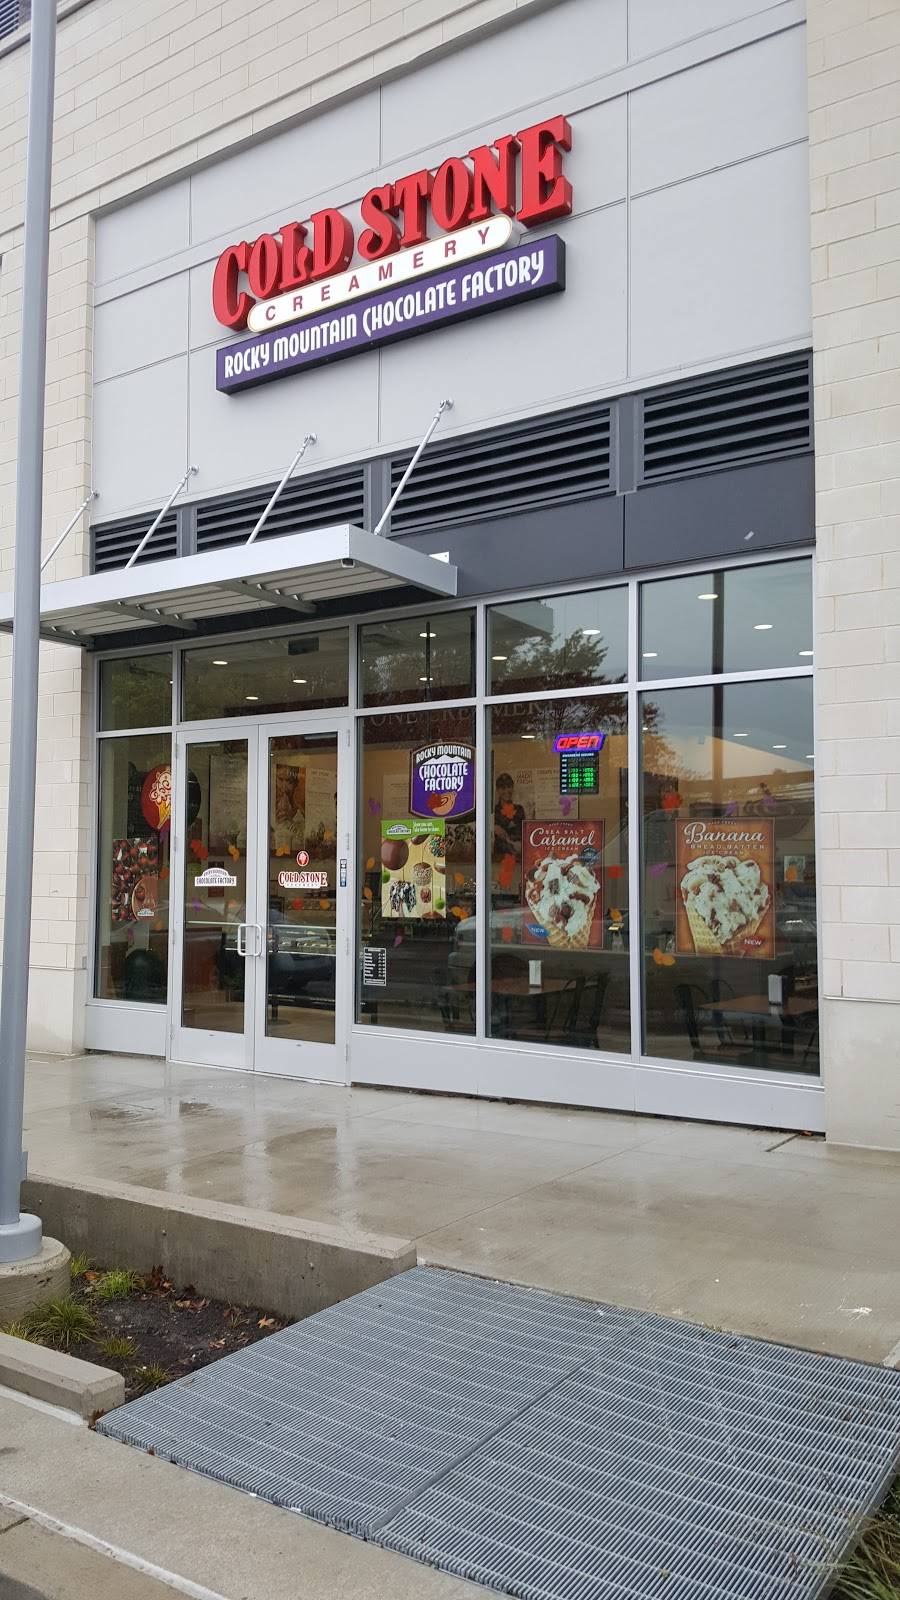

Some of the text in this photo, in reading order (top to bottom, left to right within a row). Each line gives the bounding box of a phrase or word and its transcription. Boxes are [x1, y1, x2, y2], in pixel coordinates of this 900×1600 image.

[213, 115, 572, 331] COLD STONE
[265, 227, 489, 320] CREAMERY
[224, 250, 545, 378] ROCKY MOUNTAIN CHOCOLATE FACTORY
[556, 736, 600, 750] OPEN
[416, 745, 472, 763] ROCKY MOUNTAIN
[419, 762, 468, 780] CHOCOLATE
[424, 776, 464, 791] FACTORY
[529, 828, 595, 847] Caramel
[684, 821, 766, 844] Banana
[279, 872, 300, 885] COLD
[300, 872, 327, 885] STONE
